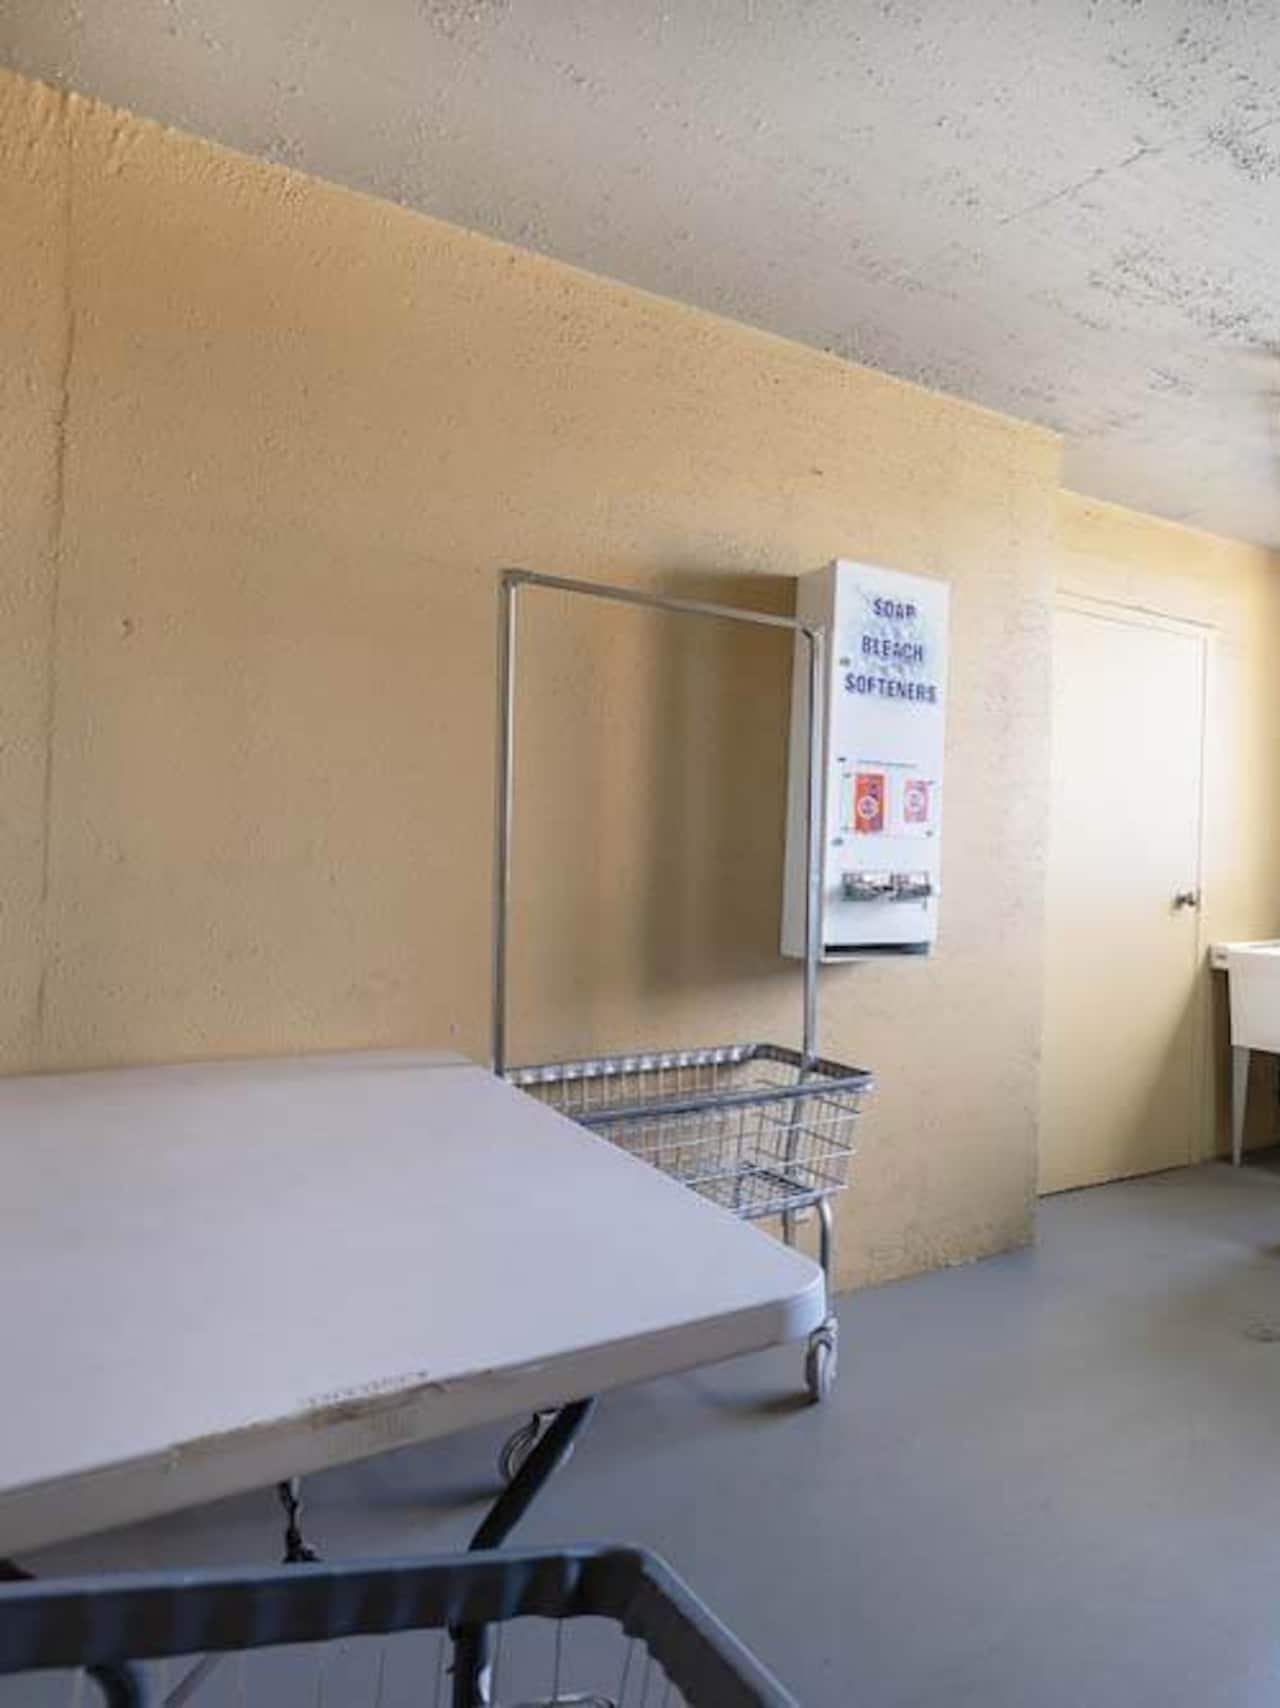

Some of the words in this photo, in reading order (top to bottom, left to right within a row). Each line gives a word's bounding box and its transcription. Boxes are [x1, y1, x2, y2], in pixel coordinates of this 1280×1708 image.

[873, 598, 916, 619] SOAP
[862, 635, 923, 662] BLEACH
[845, 673, 937, 703] SOFTENERS
